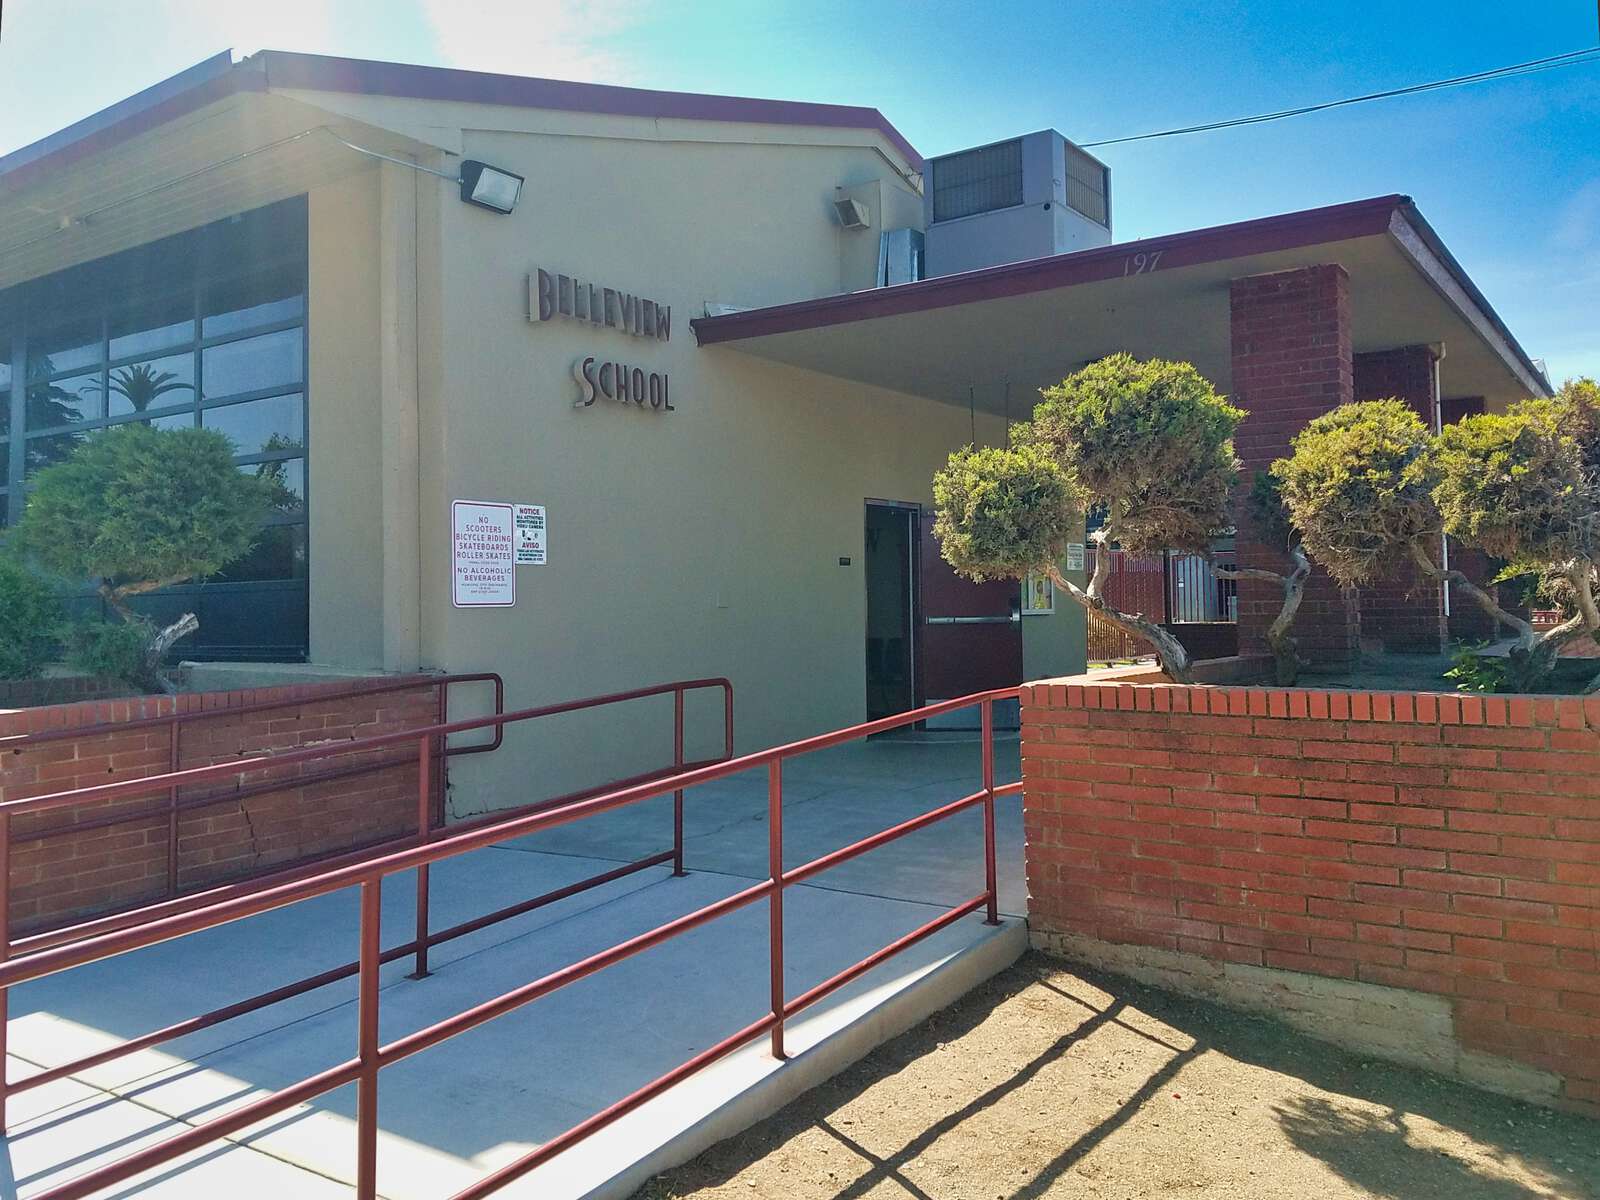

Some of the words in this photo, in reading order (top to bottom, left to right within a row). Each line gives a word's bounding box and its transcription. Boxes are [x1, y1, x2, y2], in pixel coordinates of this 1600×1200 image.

[1124, 251, 1162, 277] 197
[530, 267, 671, 342] BELLEVIEW
[574, 356, 675, 411] SCHOOL
[478, 516, 489, 524] NO
[465, 524, 502, 533] SCOOTERS
[455, 533, 485, 542] BICYCLE
[487, 534, 511, 543] RIDING
[459, 542, 509, 551] SKATEBOARDS
[521, 541, 540, 549] AVISO
[456, 551, 484, 559] ROLLER
[486, 552, 511, 560] SKATES
[470, 567, 511, 575] ALCOHOLIC
